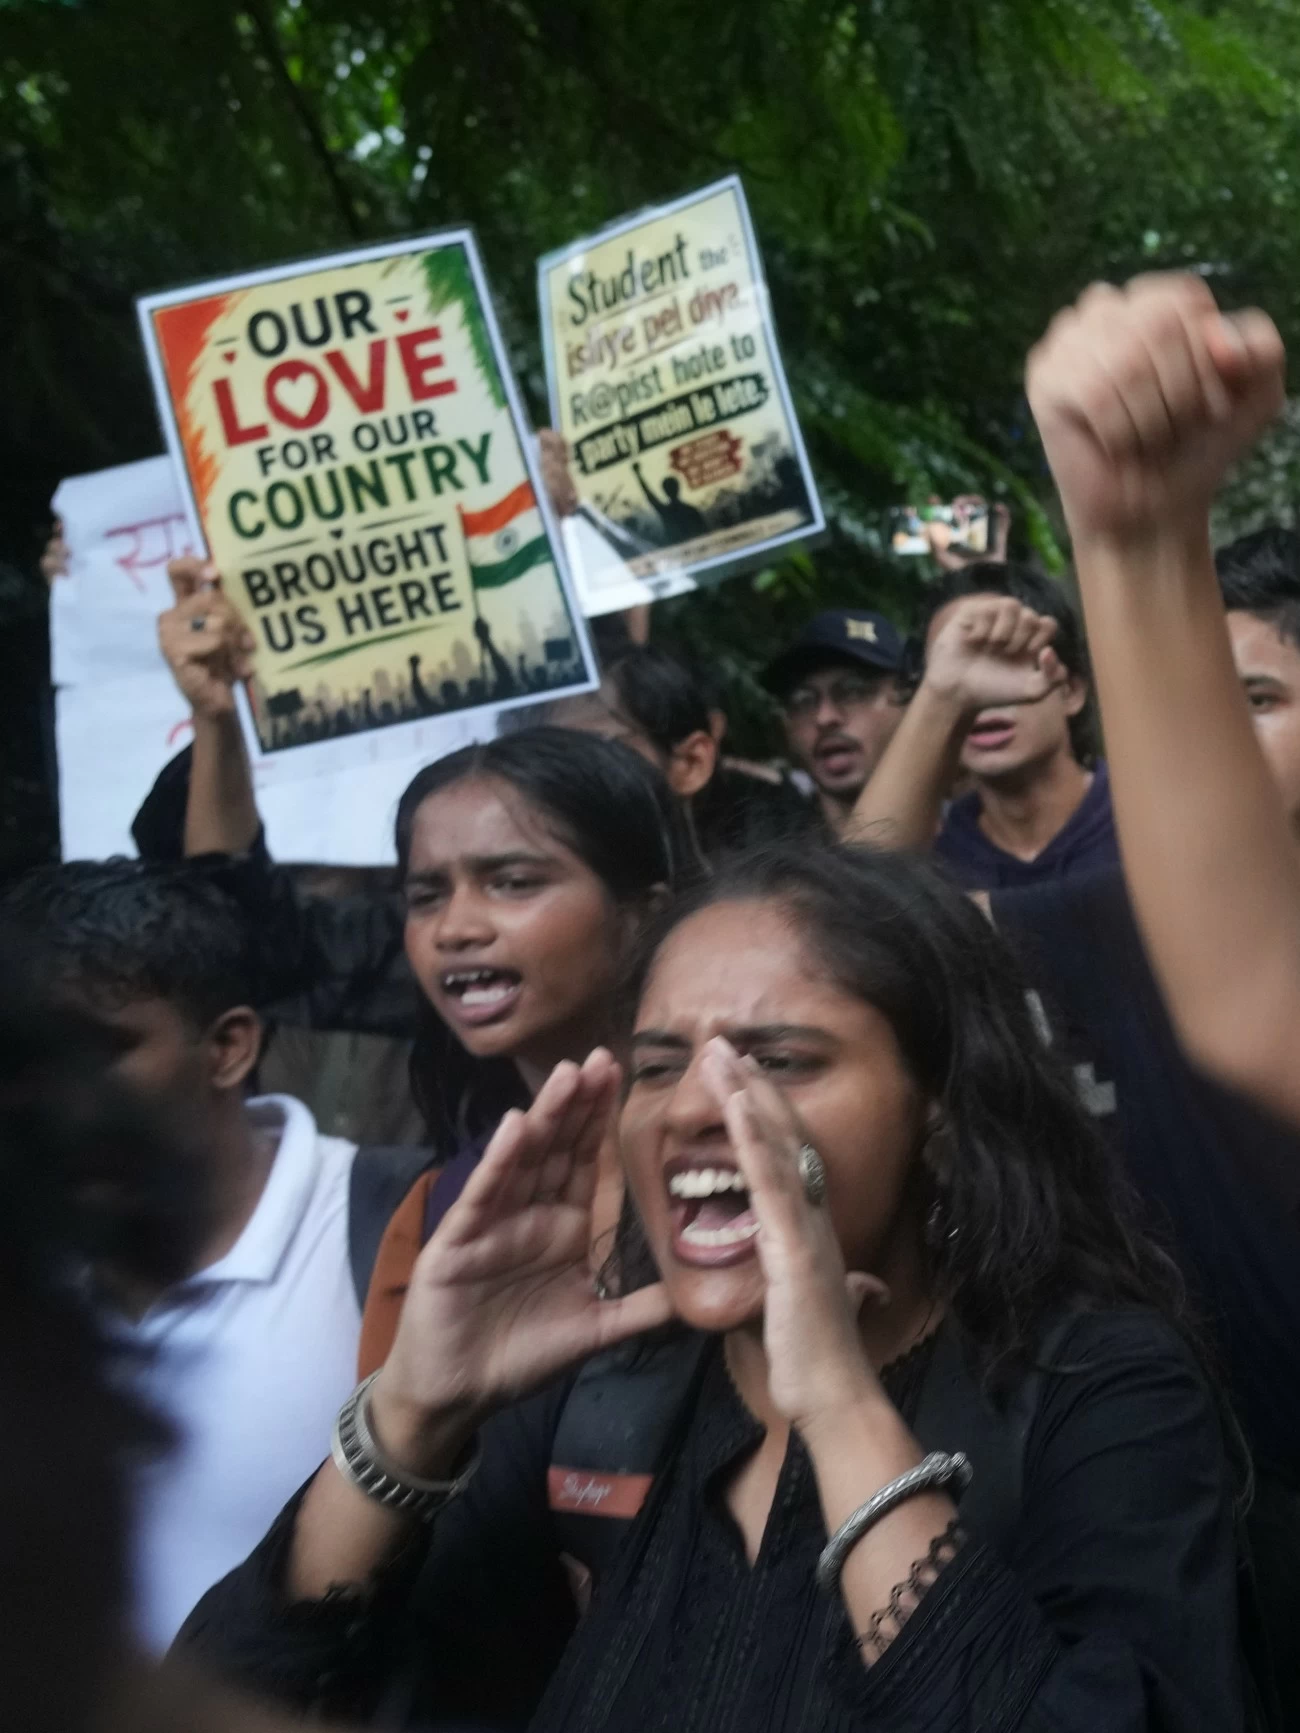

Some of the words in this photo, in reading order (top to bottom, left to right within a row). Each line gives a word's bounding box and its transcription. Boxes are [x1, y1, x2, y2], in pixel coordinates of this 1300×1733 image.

[568, 232, 689, 326] Student
[247, 290, 381, 358] OUR
[730, 333, 756, 363] to
[211, 326, 459, 447] LOVE
[256, 433, 341, 476] FOR
[352, 409, 440, 452] OUR
[226, 432, 493, 540] COUNTRY
[241, 523, 451, 608] BROUGHT
[261, 604, 328, 653] US
[338, 571, 463, 636] HERE
